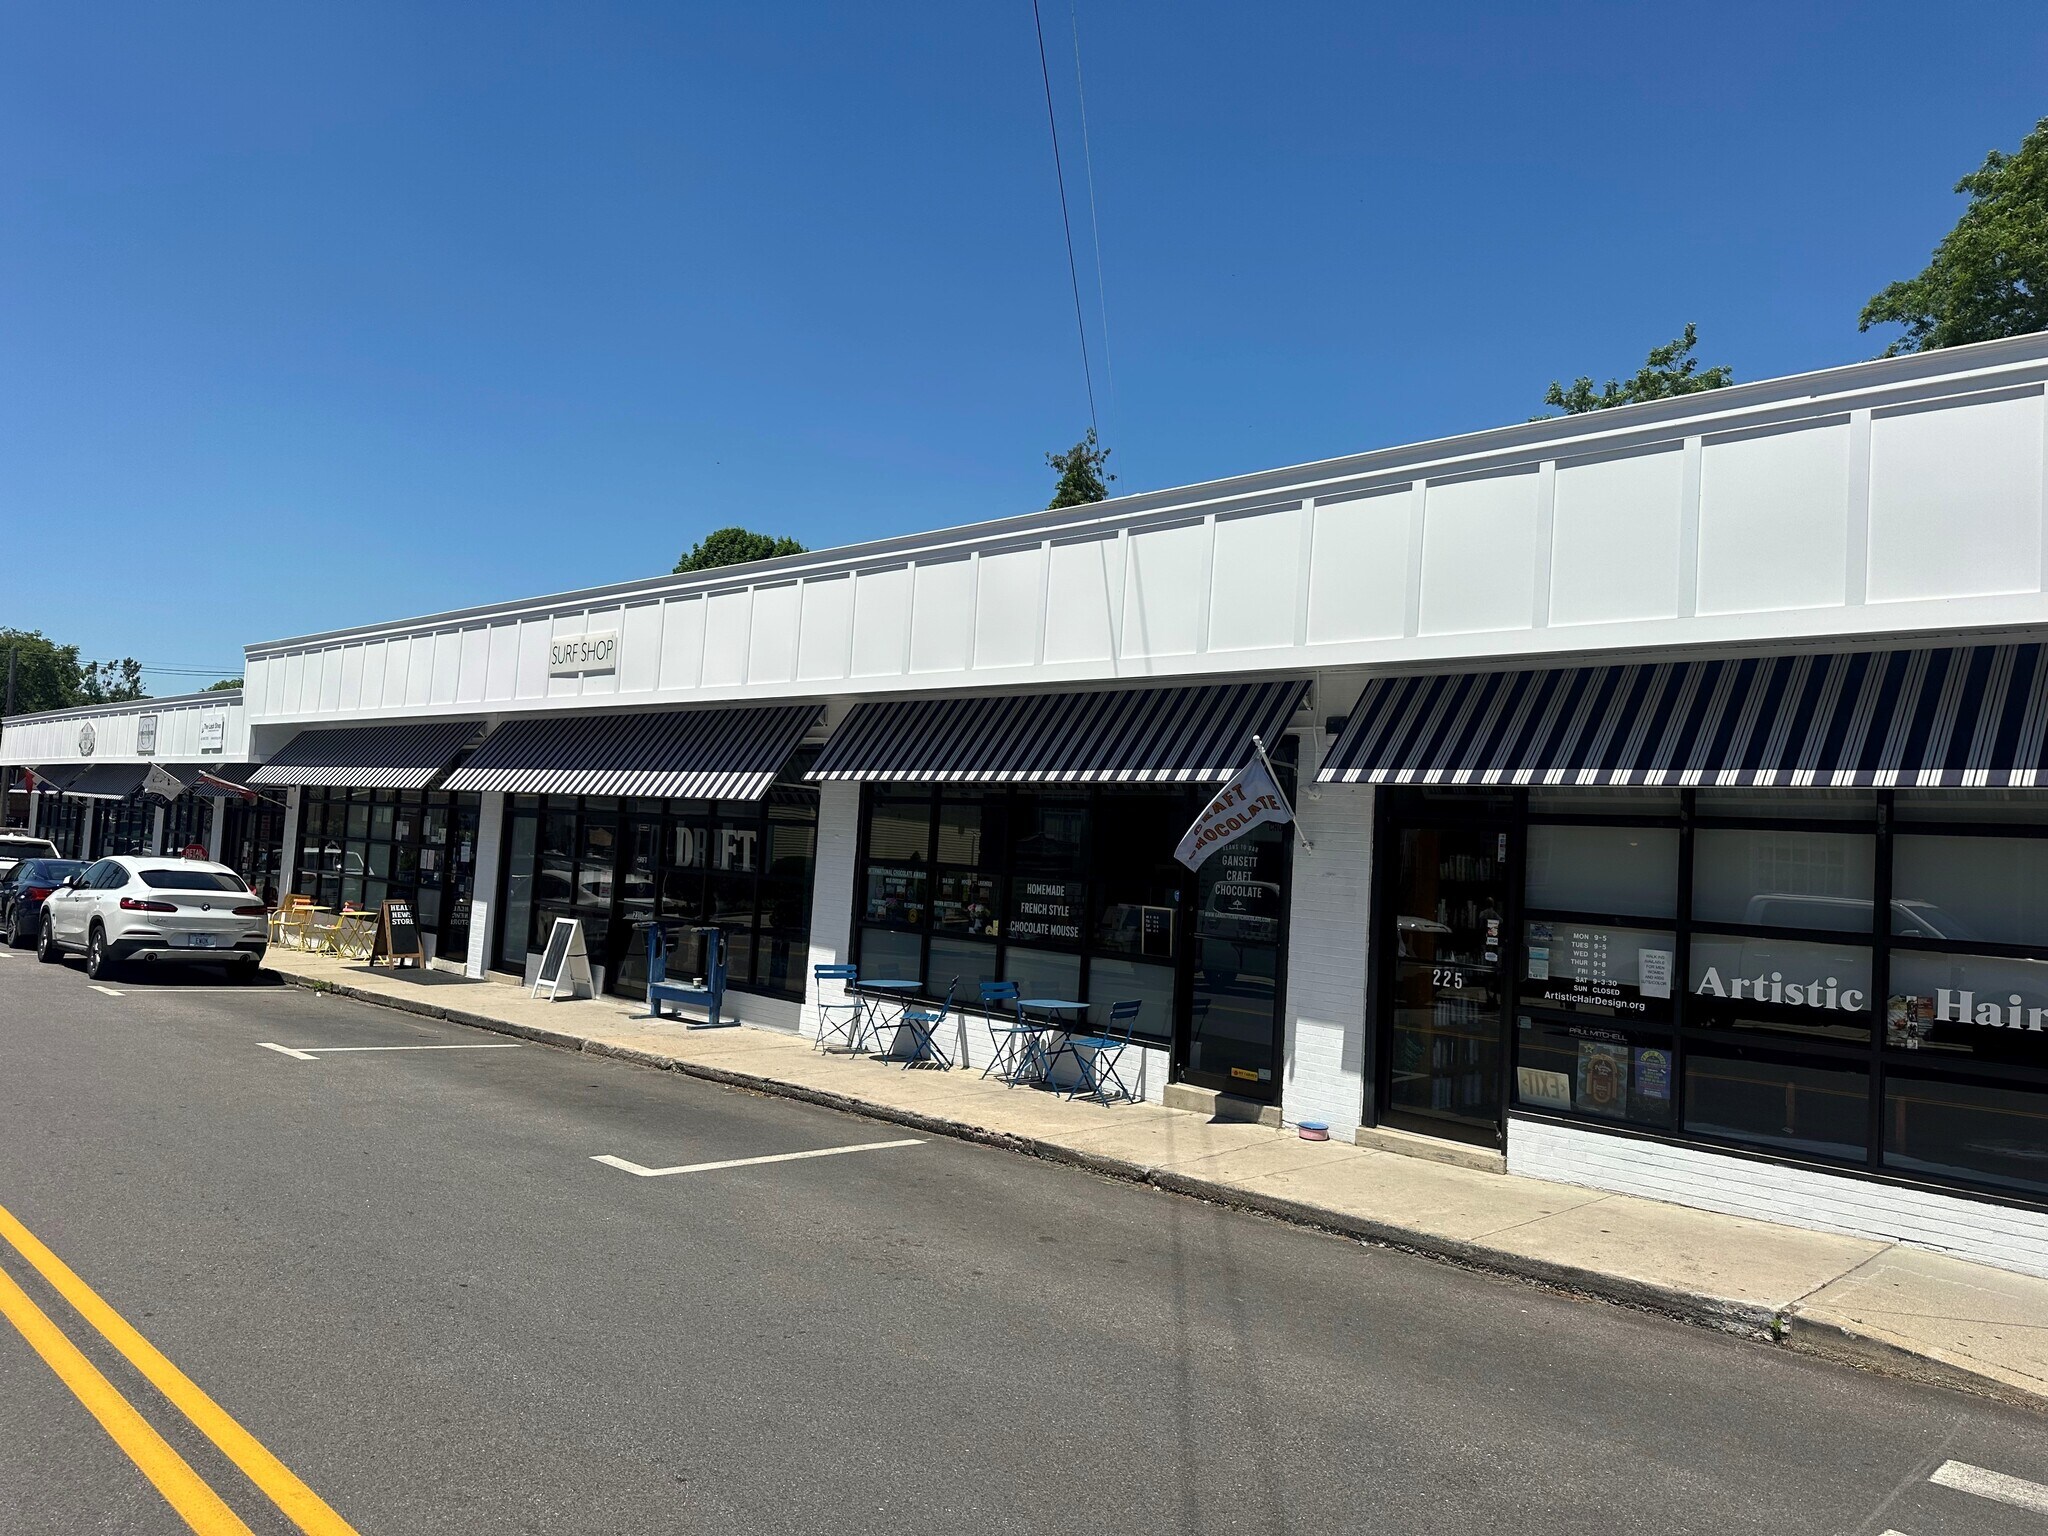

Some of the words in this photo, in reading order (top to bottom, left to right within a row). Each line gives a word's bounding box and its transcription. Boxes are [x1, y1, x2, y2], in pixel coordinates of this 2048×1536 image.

[551, 643, 578, 664] SURF
[580, 640, 614, 662] SHOP
[137, 790, 167, 804] OEN
[675, 827, 757, 872] DRIFT
[1222, 855, 1258, 867] GANSETT
[1226, 870, 1252, 882] CRAFT
[1026, 884, 1065, 896] HOMEMADE
[1215, 884, 1262, 898] CHOCOLATE
[1021, 902, 1047, 915] FRENCH
[1049, 904, 1070, 917] STYLE
[1010, 920, 1049, 935] CHOCOLATE
[1050, 924, 1079, 938] MOUSSE
[1433, 969, 1462, 989] 225
[1592, 987, 1620, 996] CLOSED
[1694, 966, 1864, 1012] Artistic
[1544, 991, 1645, 1011] ArtisticHairDesign.org
[1934, 988, 2048, 1032] Hair
[1569, 1027, 1589, 1036] PAUL
[1590, 1030, 1628, 1041] MITCHELL
